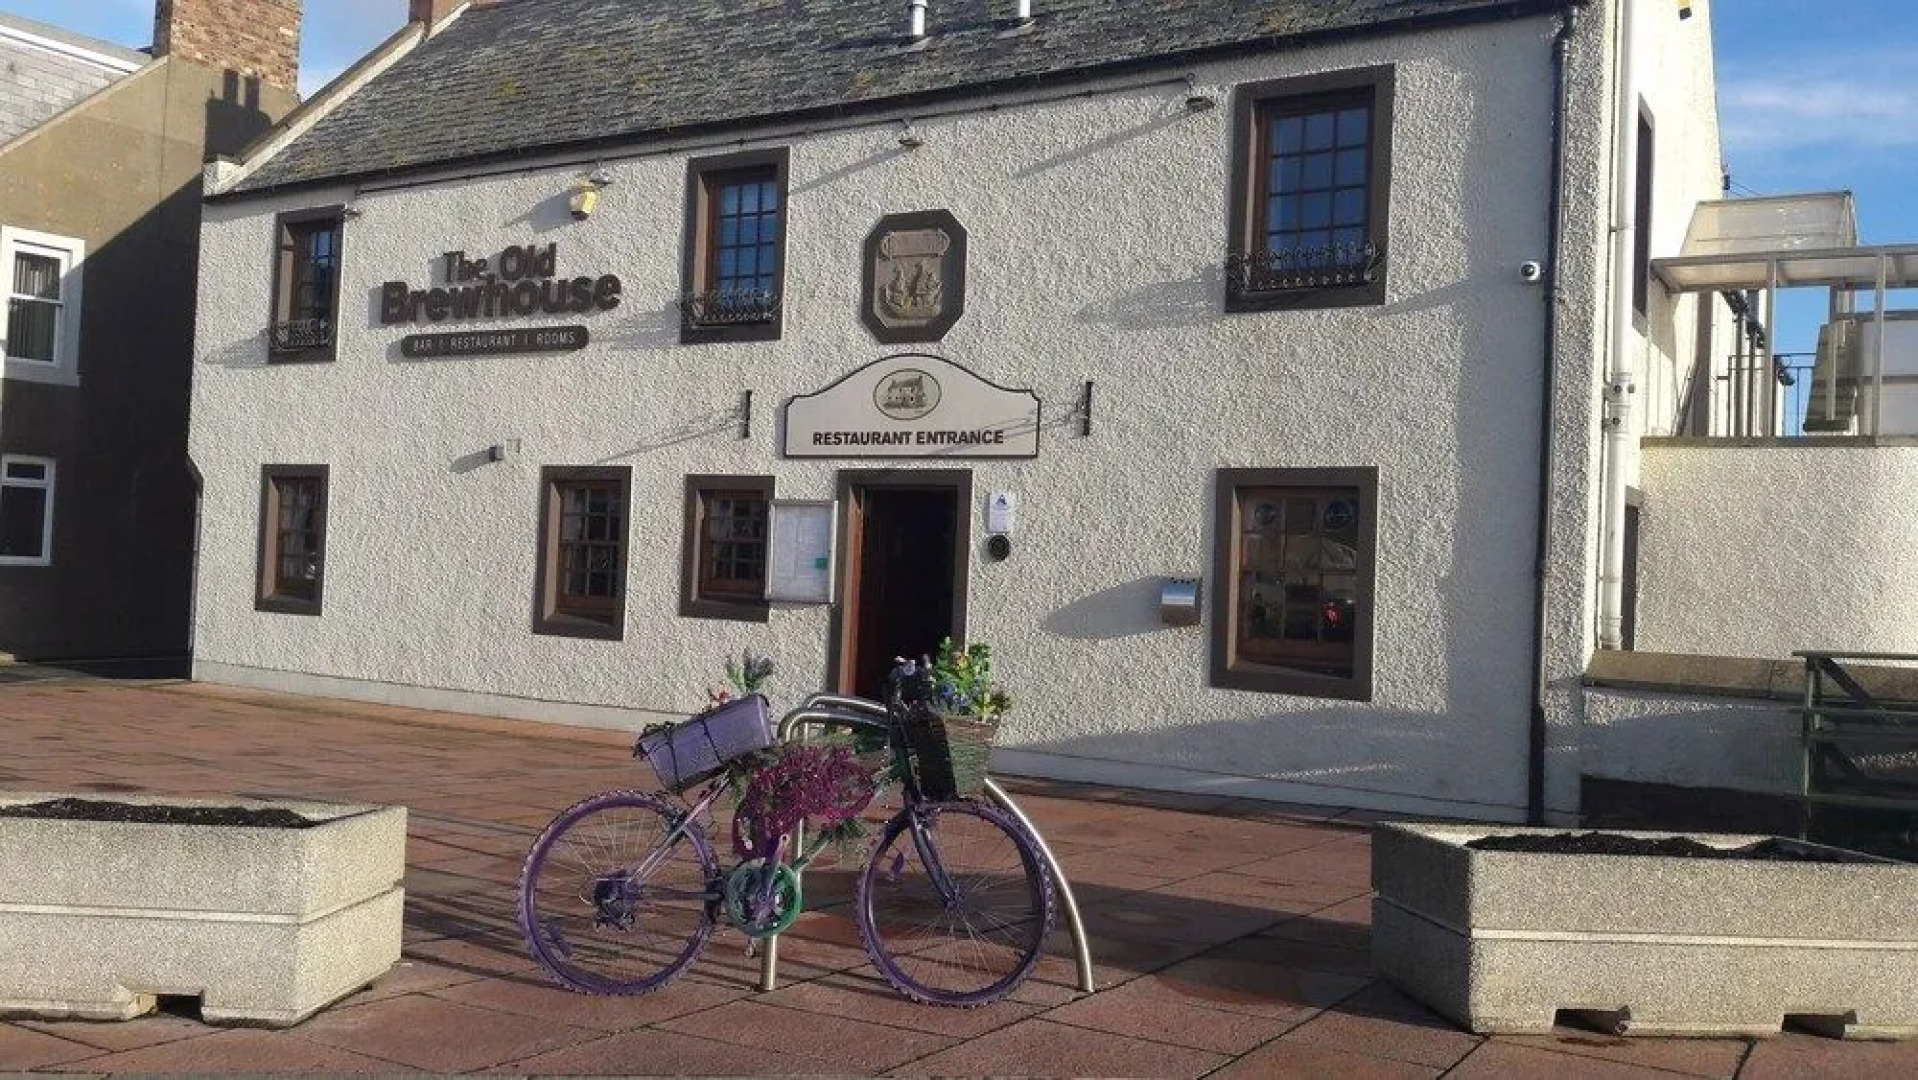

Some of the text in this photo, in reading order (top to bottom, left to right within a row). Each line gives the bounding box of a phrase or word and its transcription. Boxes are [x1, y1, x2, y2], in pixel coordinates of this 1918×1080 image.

[443, 243, 556, 282] The Old
[381, 274, 621, 324] Brewhouse
[413, 331, 575, 351] BAR RESTAURANT ROOMS
[812, 429, 1004, 446] RESTAURANT ENTRANCE
